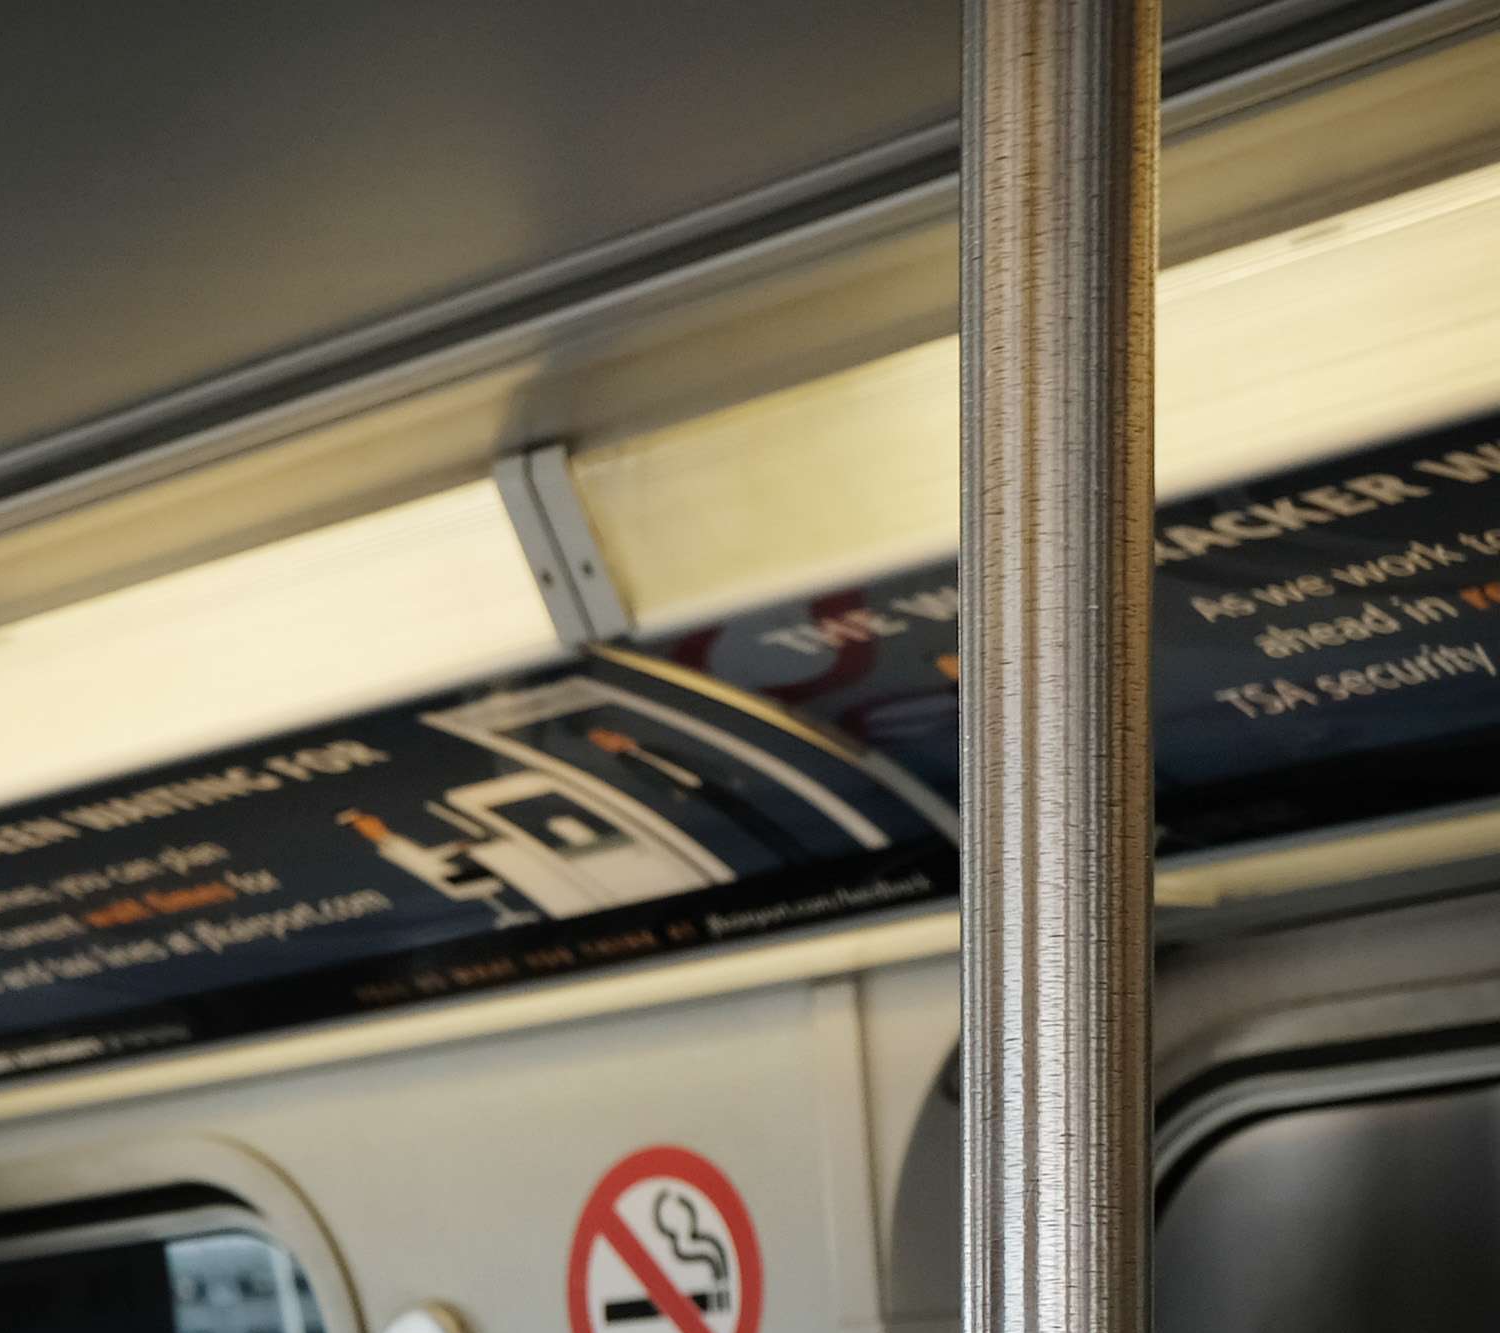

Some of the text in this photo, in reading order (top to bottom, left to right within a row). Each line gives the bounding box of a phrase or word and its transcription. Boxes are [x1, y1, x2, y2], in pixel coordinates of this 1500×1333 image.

[1155, 472, 1432, 567] ACKER
[1191, 586, 1255, 623] As
[1252, 572, 1334, 607] we
[1332, 539, 1467, 587] work
[1255, 604, 1399, 660] ahead
[1399, 594, 1460, 627] in
[1217, 642, 1498, 720] TSA security
[62, 766, 282, 831] WAITING
[265, 740, 391, 781] FOR
